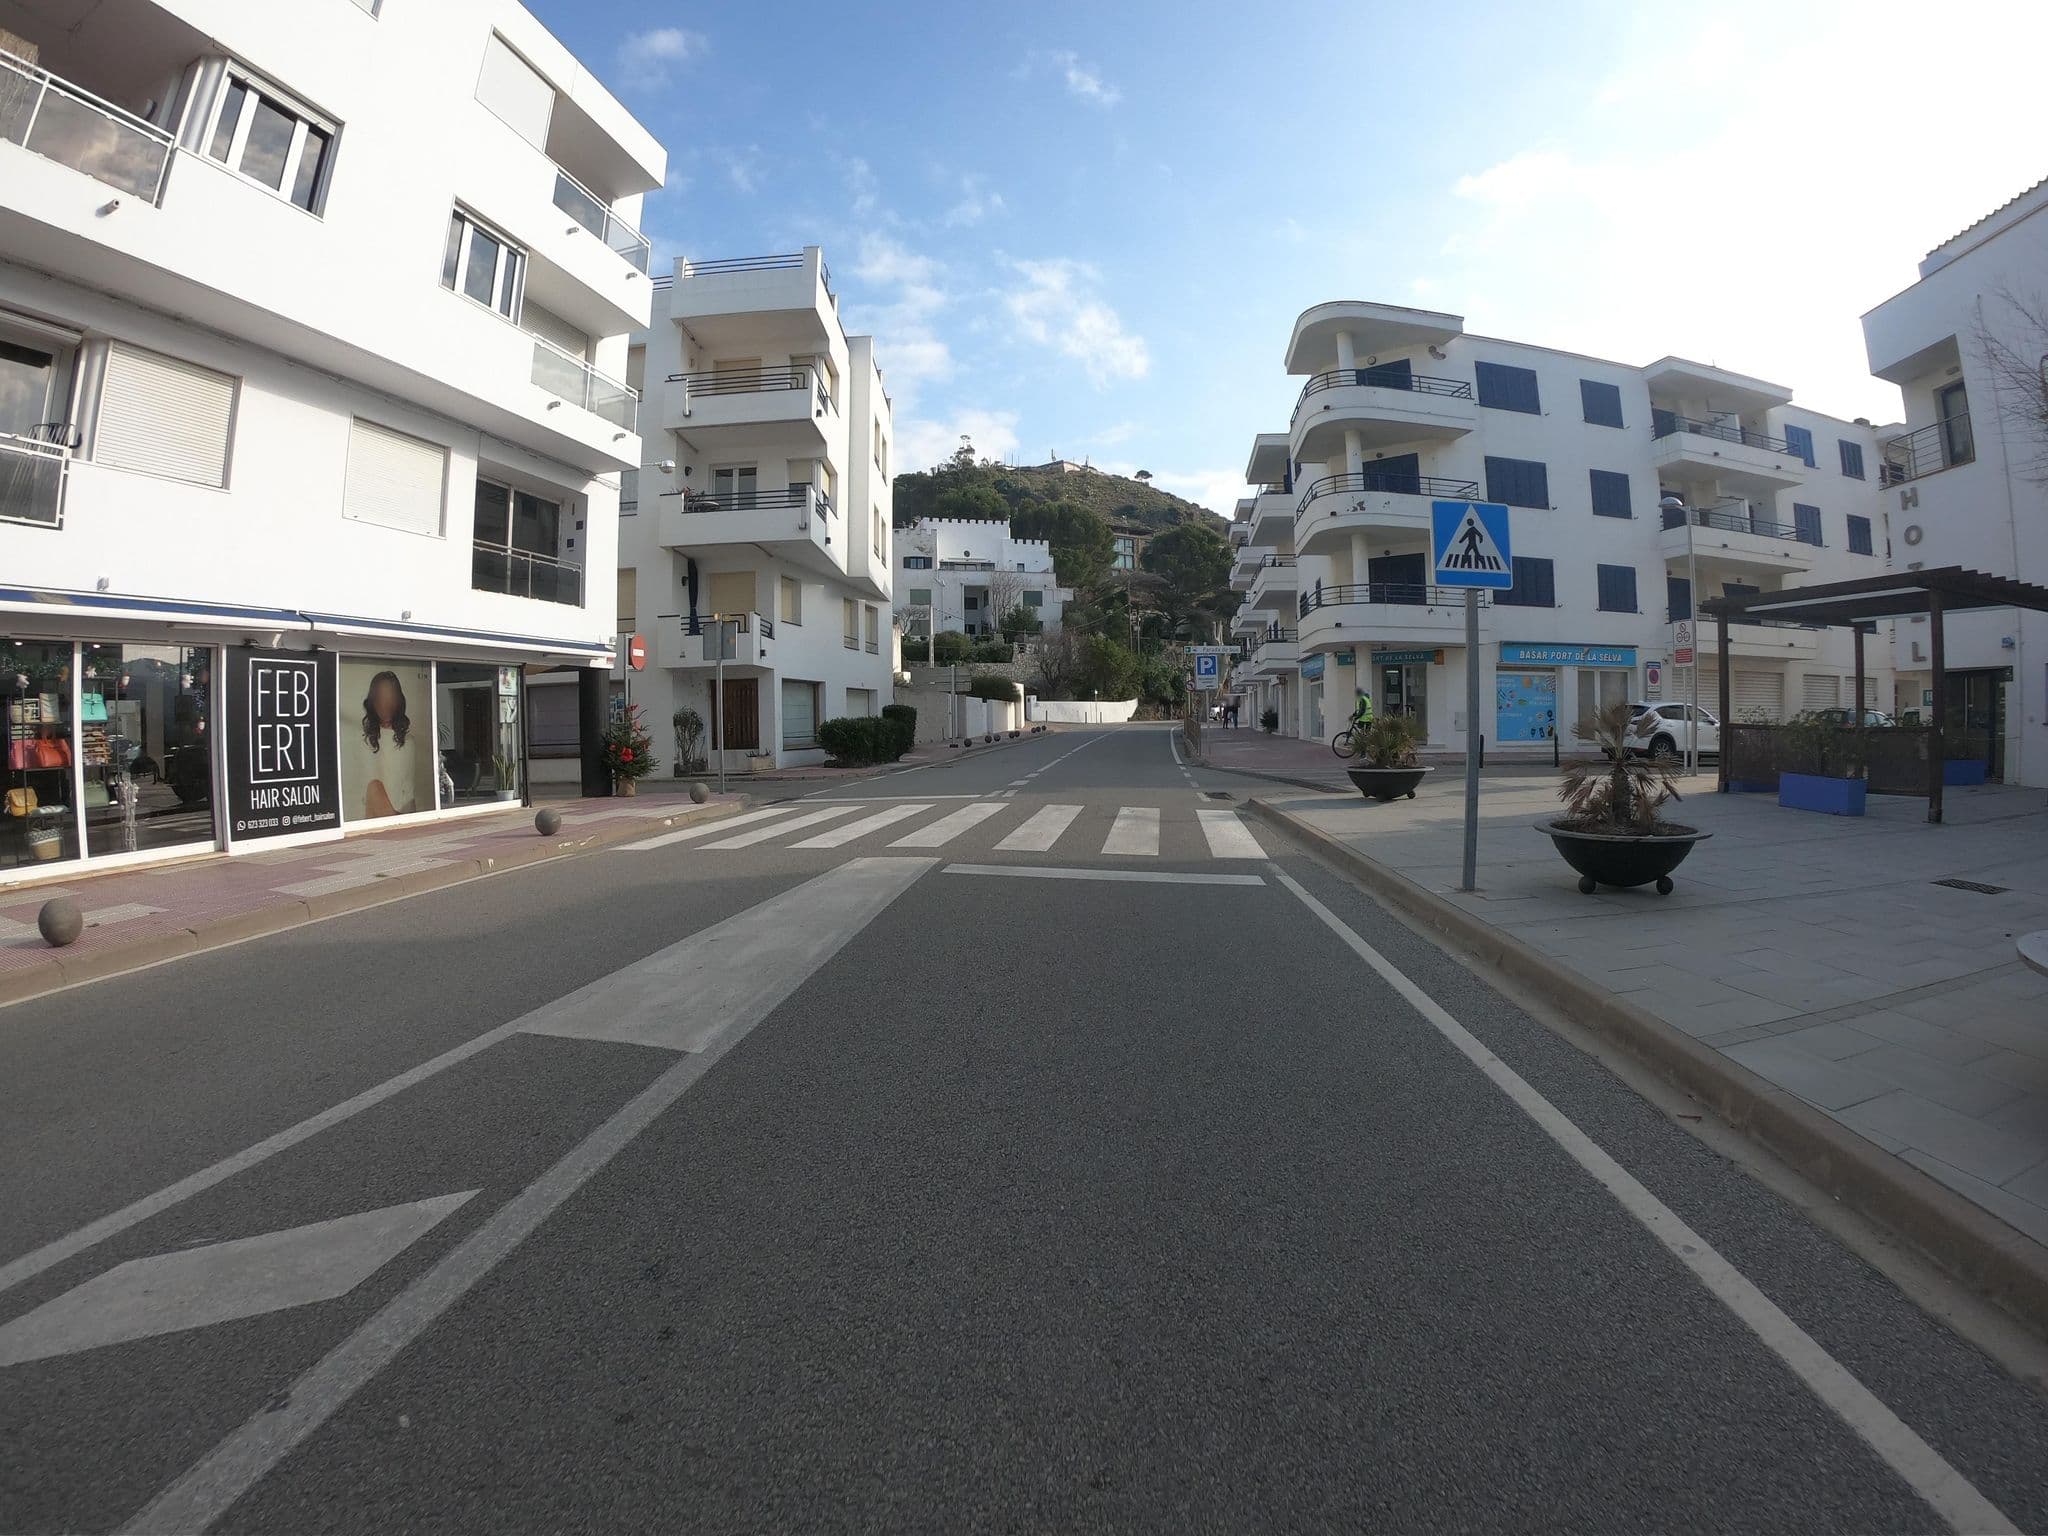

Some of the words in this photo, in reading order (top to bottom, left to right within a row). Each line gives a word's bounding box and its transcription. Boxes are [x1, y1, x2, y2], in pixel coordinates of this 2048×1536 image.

[1900, 487, 1927, 662] HOL
[1519, 650, 1548, 660] BASAR
[1550, 651, 1573, 661] PORT
[1575, 652, 1585, 661] DE
[1587, 652, 1597, 661] LA
[1599, 653, 1622, 662] SELVA
[257, 669, 310, 717] FEB
[257, 723, 310, 772] ERT
[251, 787, 280, 810] HAIR
[281, 784, 320, 808] SALON
